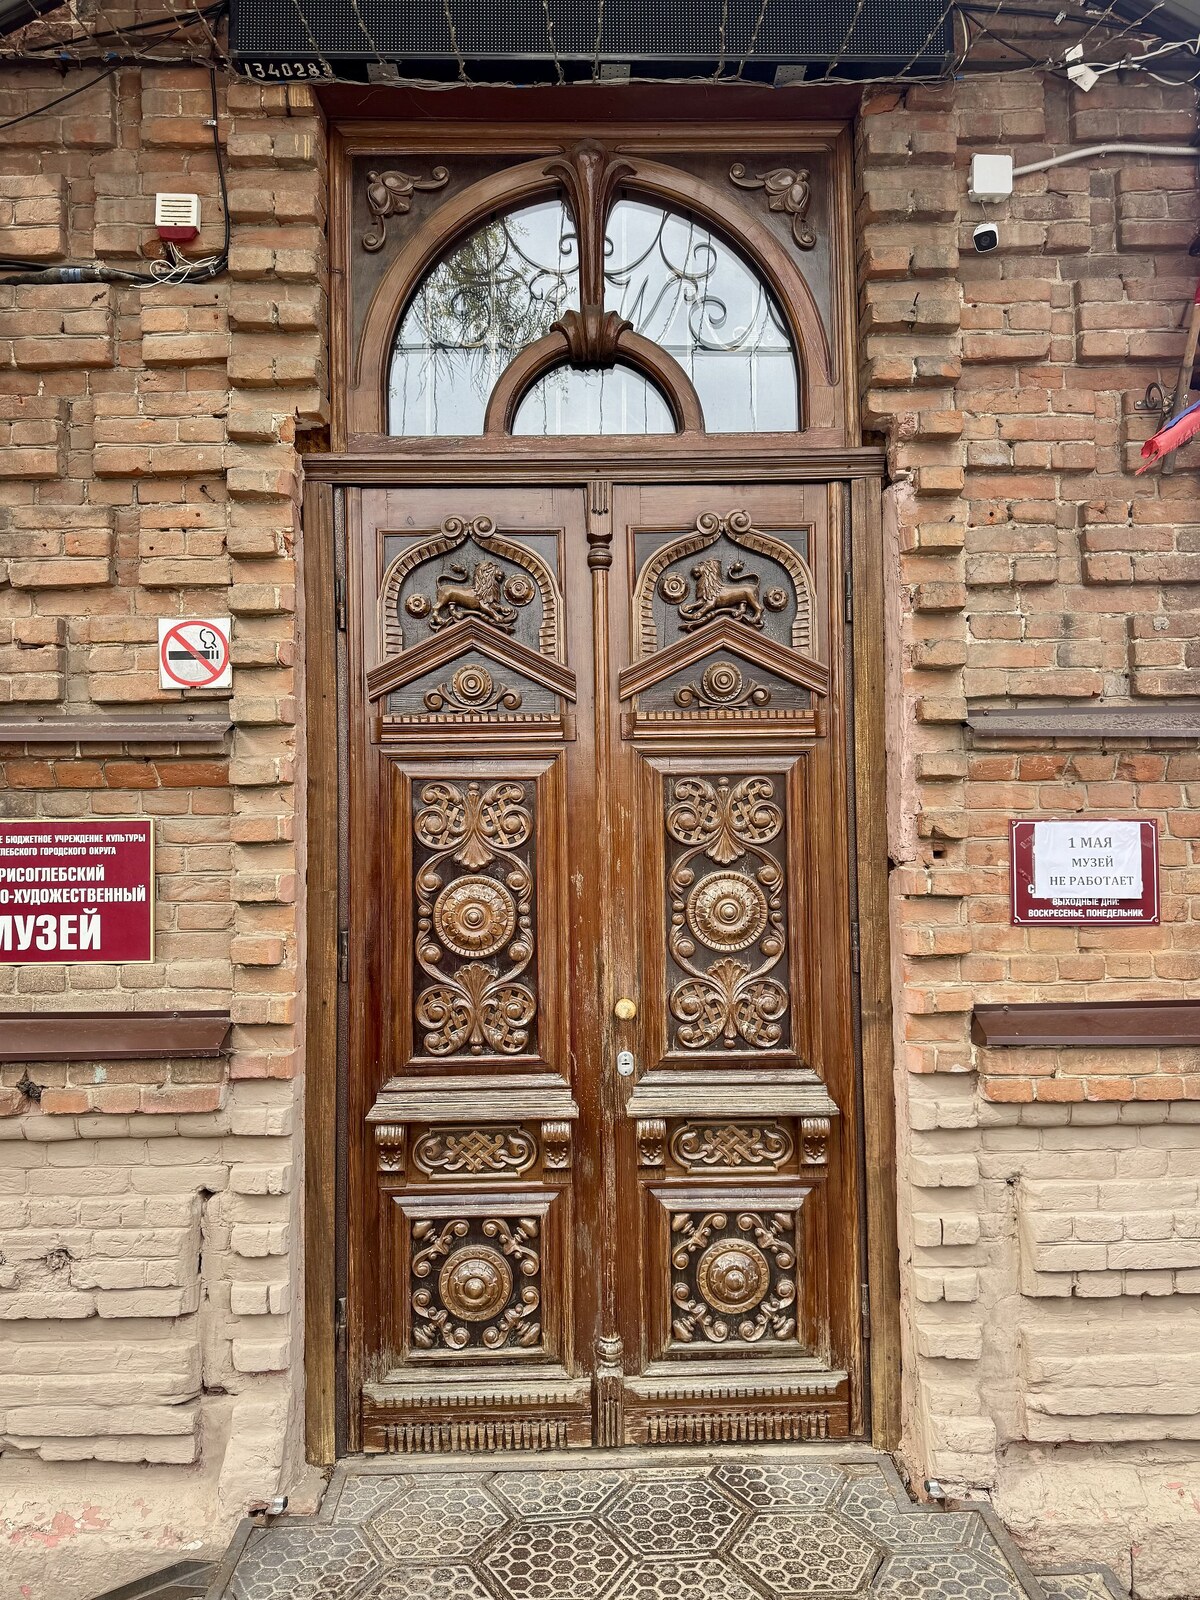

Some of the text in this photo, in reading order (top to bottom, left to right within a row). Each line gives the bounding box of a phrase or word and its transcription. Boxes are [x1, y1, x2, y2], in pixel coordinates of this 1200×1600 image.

[5, 835, 52, 844] БЮДЖЕТНОЕ
[54, 834, 103, 843] УЧРЕЖДЕНИЕ
[105, 834, 146, 842] КУЛЬТУРЫ
[1069, 837, 1112, 848] 1 МАЯ
[40, 847, 87, 856] ГОРОДСКОГО
[89, 847, 116, 855] ОКРУГА
[1071, 856, 1114, 867] МУЗЕЙ
[1049, 876, 1135, 886] НЕ РАБОТАЕТ
[1052, 898, 1099, 906] ВЫХОДНЫЕ
[1028, 908, 1143, 918] ВОСКРЕСЕНЬЕ, ПОНЕДЕЛЬНИК
